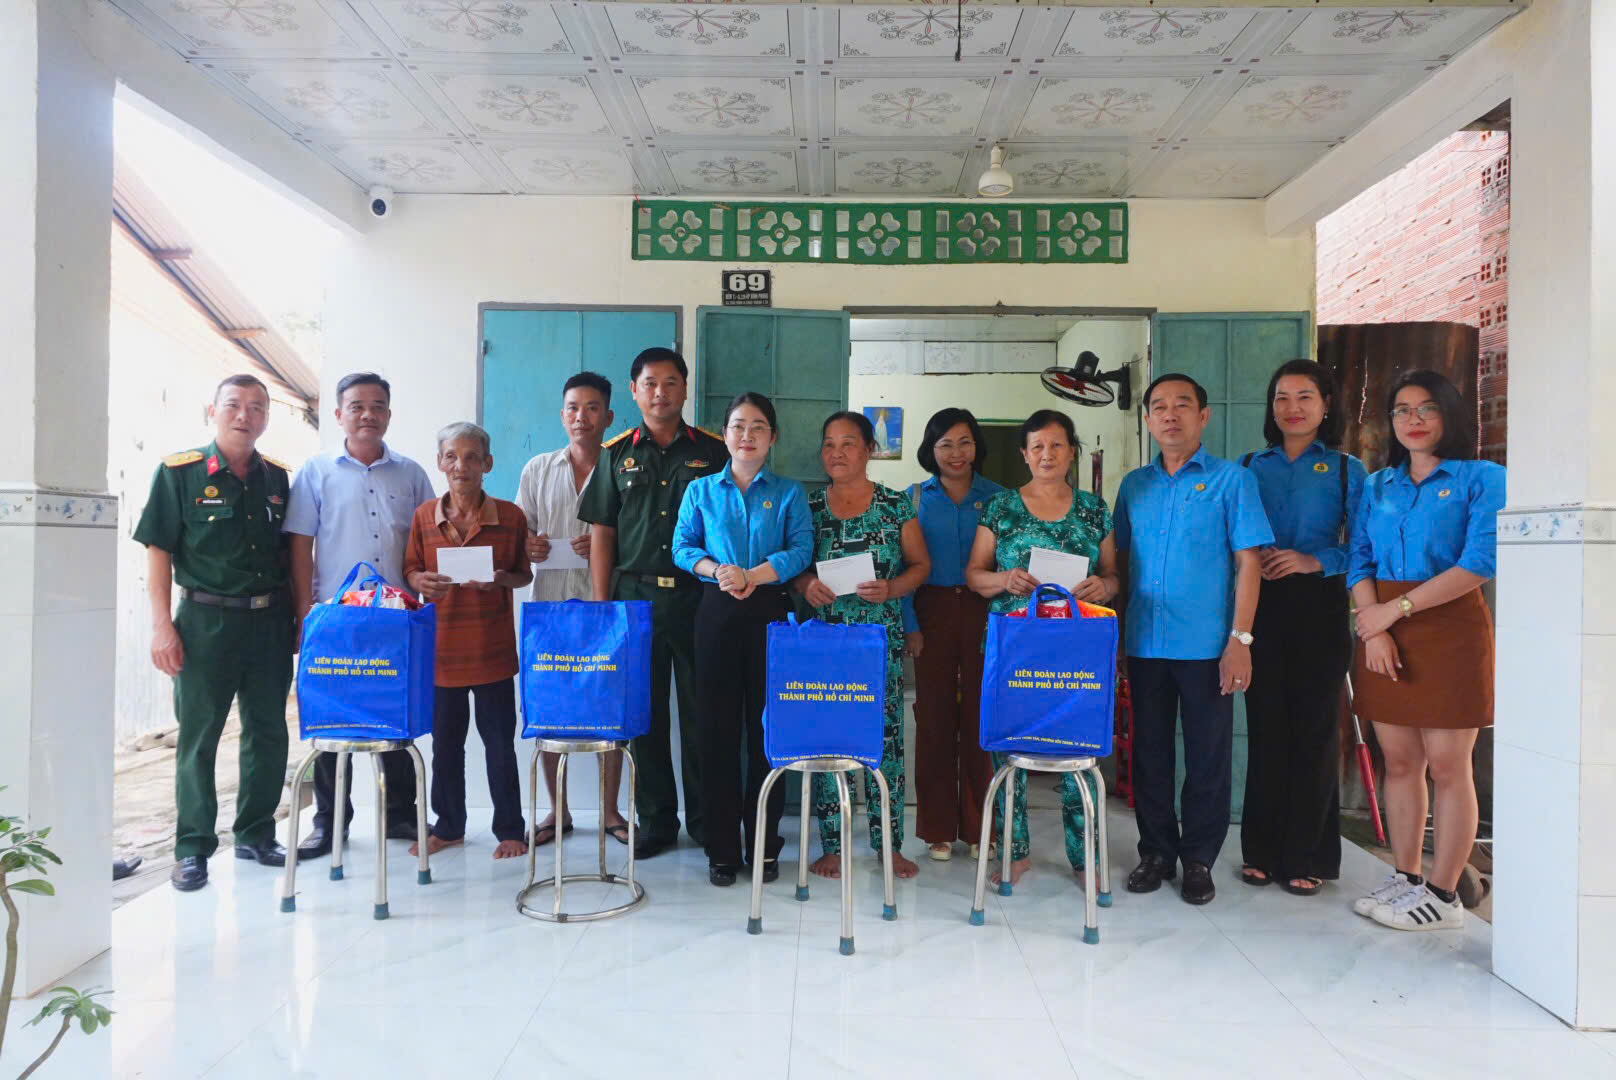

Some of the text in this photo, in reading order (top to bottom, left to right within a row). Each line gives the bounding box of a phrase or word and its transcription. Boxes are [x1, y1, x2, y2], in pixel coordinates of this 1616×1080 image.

[729, 273, 765, 292] 69
[537, 653, 552, 661] LIÊN
[554, 654, 575, 662] ĐOÀN
[592, 654, 610, 663] ĐỘNG
[1015, 669, 1095, 681] LIÊN ĐOÀN LAO ĐỘNG
[786, 681, 804, 690] LIÊN
[806, 681, 827, 690] ĐOÀN
[846, 683, 868, 692] ĐỘNG
[1008, 679, 1034, 688] THÀNH
[1066, 681, 1080, 689] CHÍ
[779, 692, 805, 701] THÀNH
[838, 693, 852, 702] CHÍ
[854, 694, 875, 702] MINH
